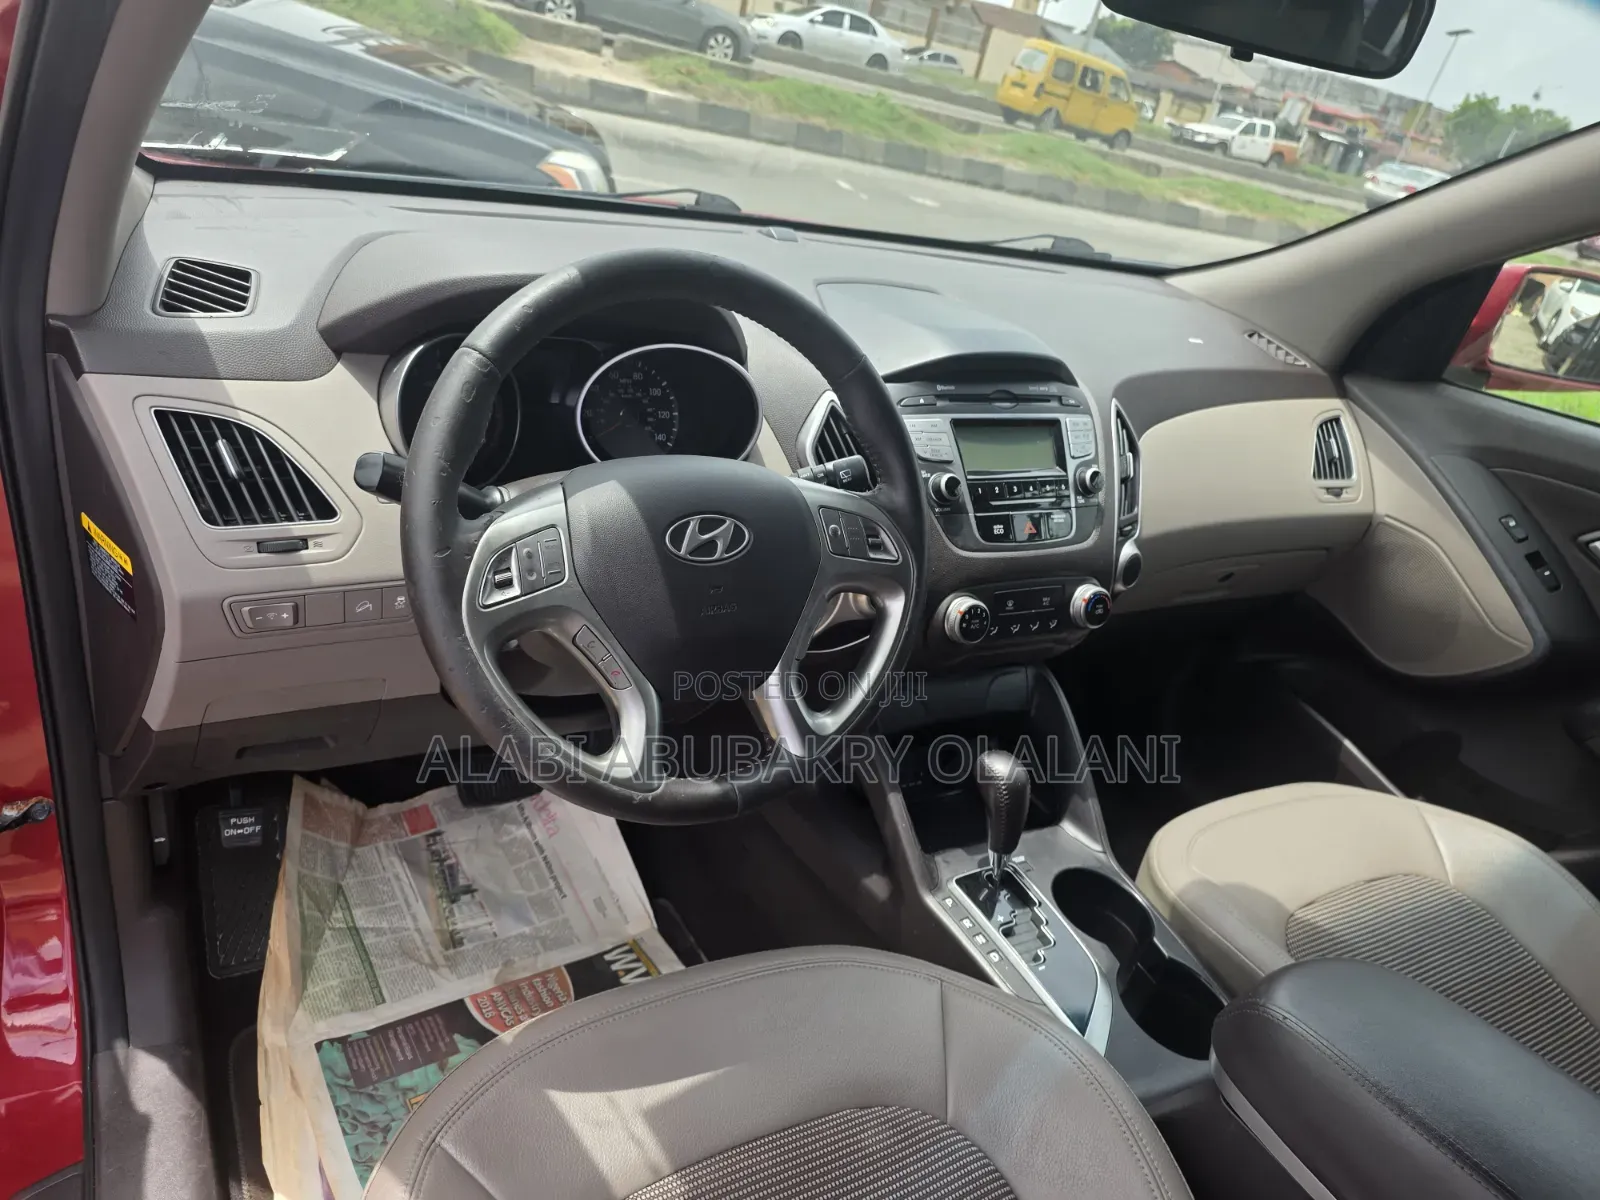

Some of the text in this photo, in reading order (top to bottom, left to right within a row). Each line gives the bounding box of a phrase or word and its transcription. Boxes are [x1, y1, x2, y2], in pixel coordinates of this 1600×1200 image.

[649, 387, 661, 396] 100
[658, 410, 670, 419] 120
[654, 433, 667, 442] 140
[230, 817, 255, 826] PUSH
[532, 978, 554, 1007] fashion
[519, 981, 541, 1016] industry
[490, 991, 515, 1026] AMVCAs
